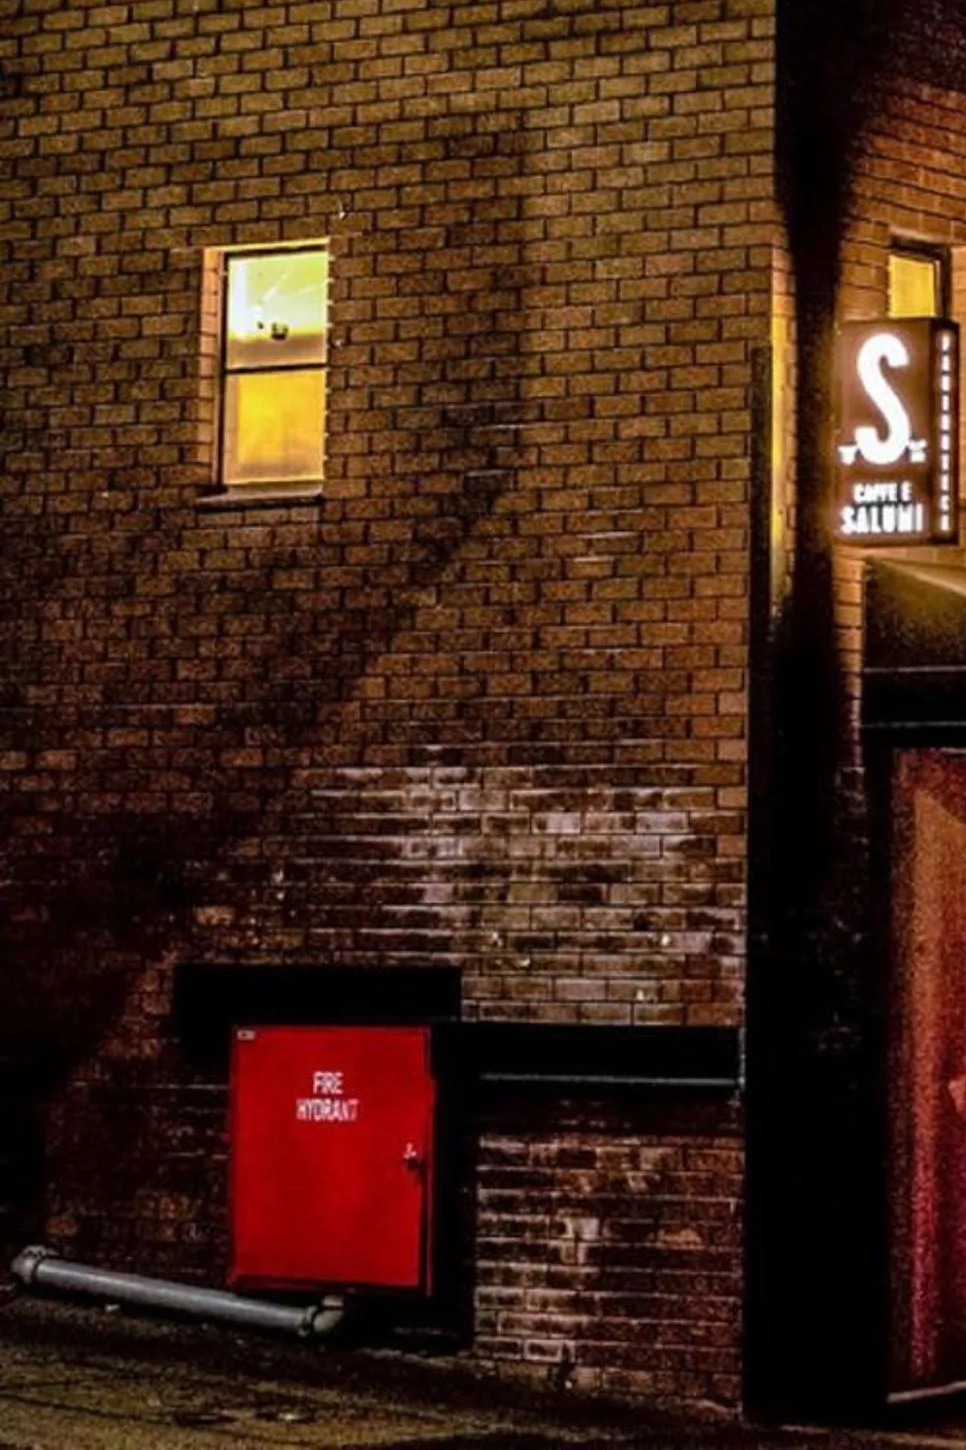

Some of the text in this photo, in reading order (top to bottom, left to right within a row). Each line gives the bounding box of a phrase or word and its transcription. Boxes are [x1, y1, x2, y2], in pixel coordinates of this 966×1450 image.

[854, 333, 910, 466] S
[313, 1071, 344, 1094] FIRE
[296, 1098, 359, 1122] HYDRANT
